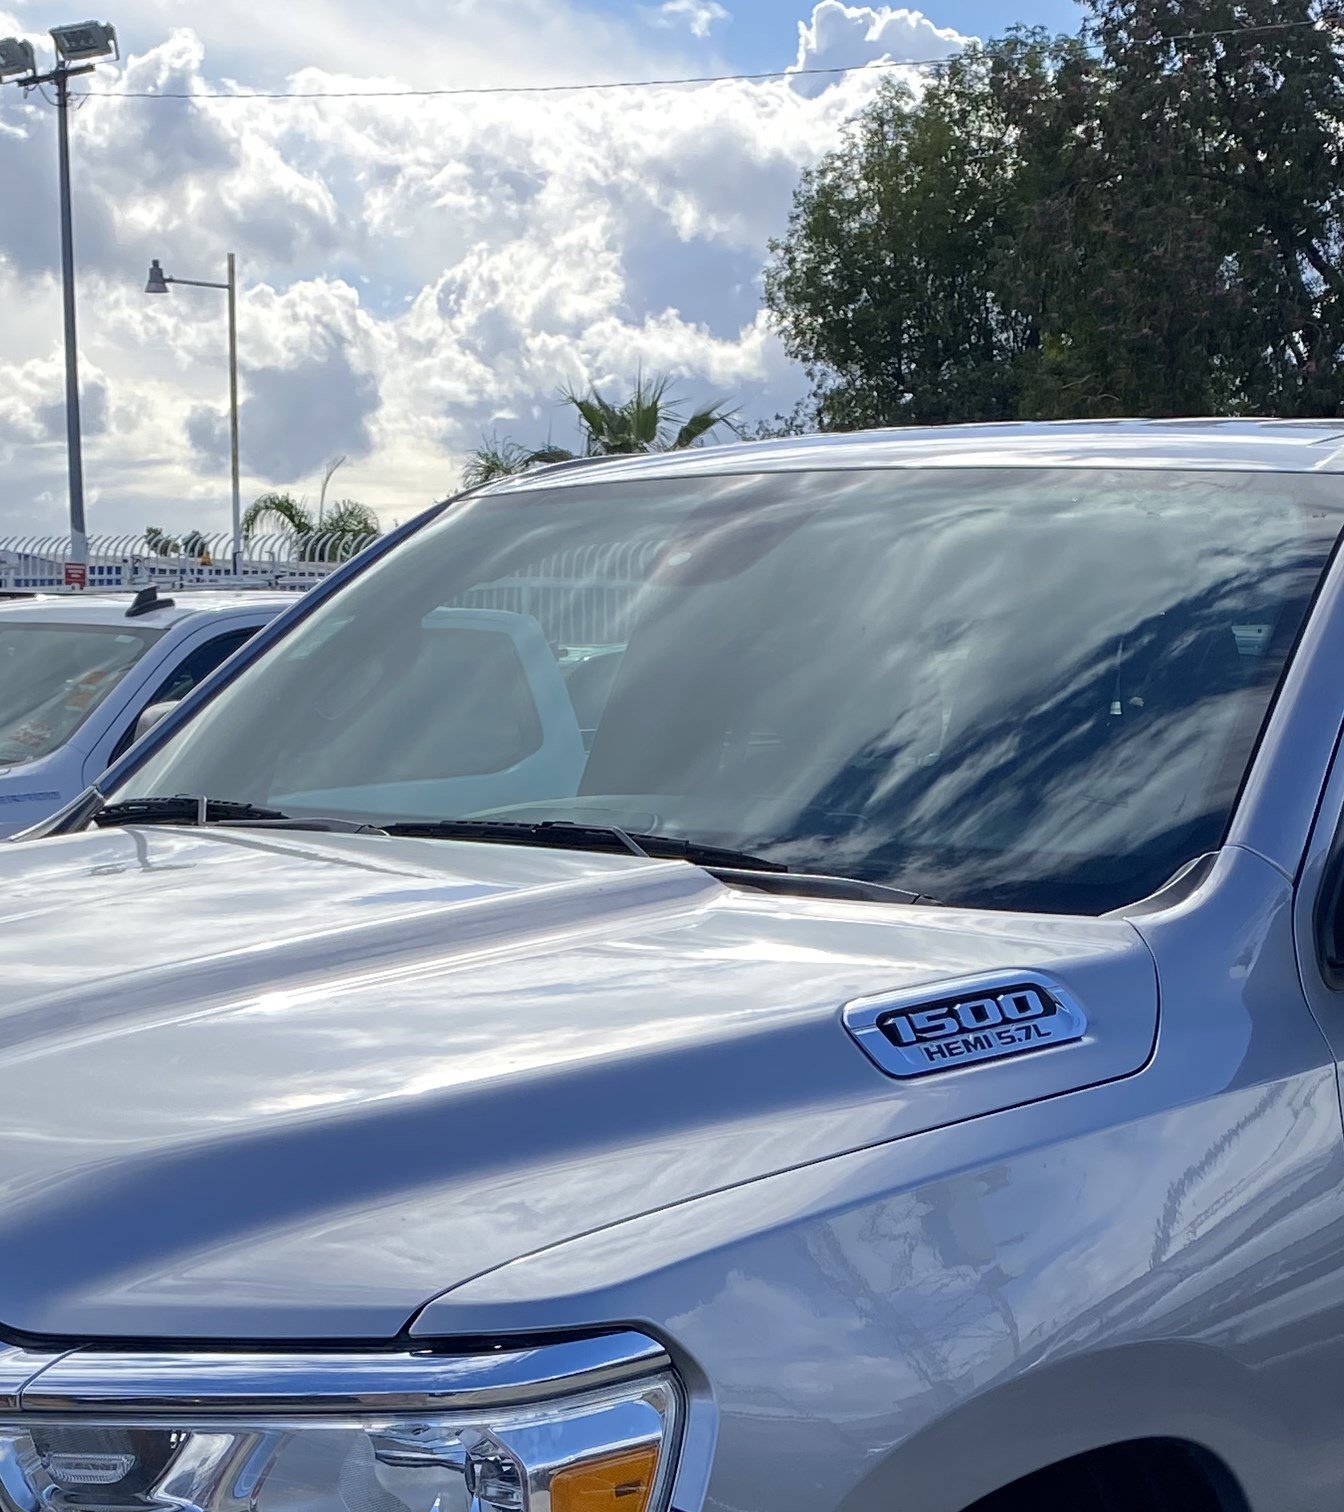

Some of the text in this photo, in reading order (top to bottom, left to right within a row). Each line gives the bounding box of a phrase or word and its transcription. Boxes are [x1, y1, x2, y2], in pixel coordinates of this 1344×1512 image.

[884, 990, 1044, 1043] 1500
[924, 1024, 1052, 1062] HEMI 5.7L
